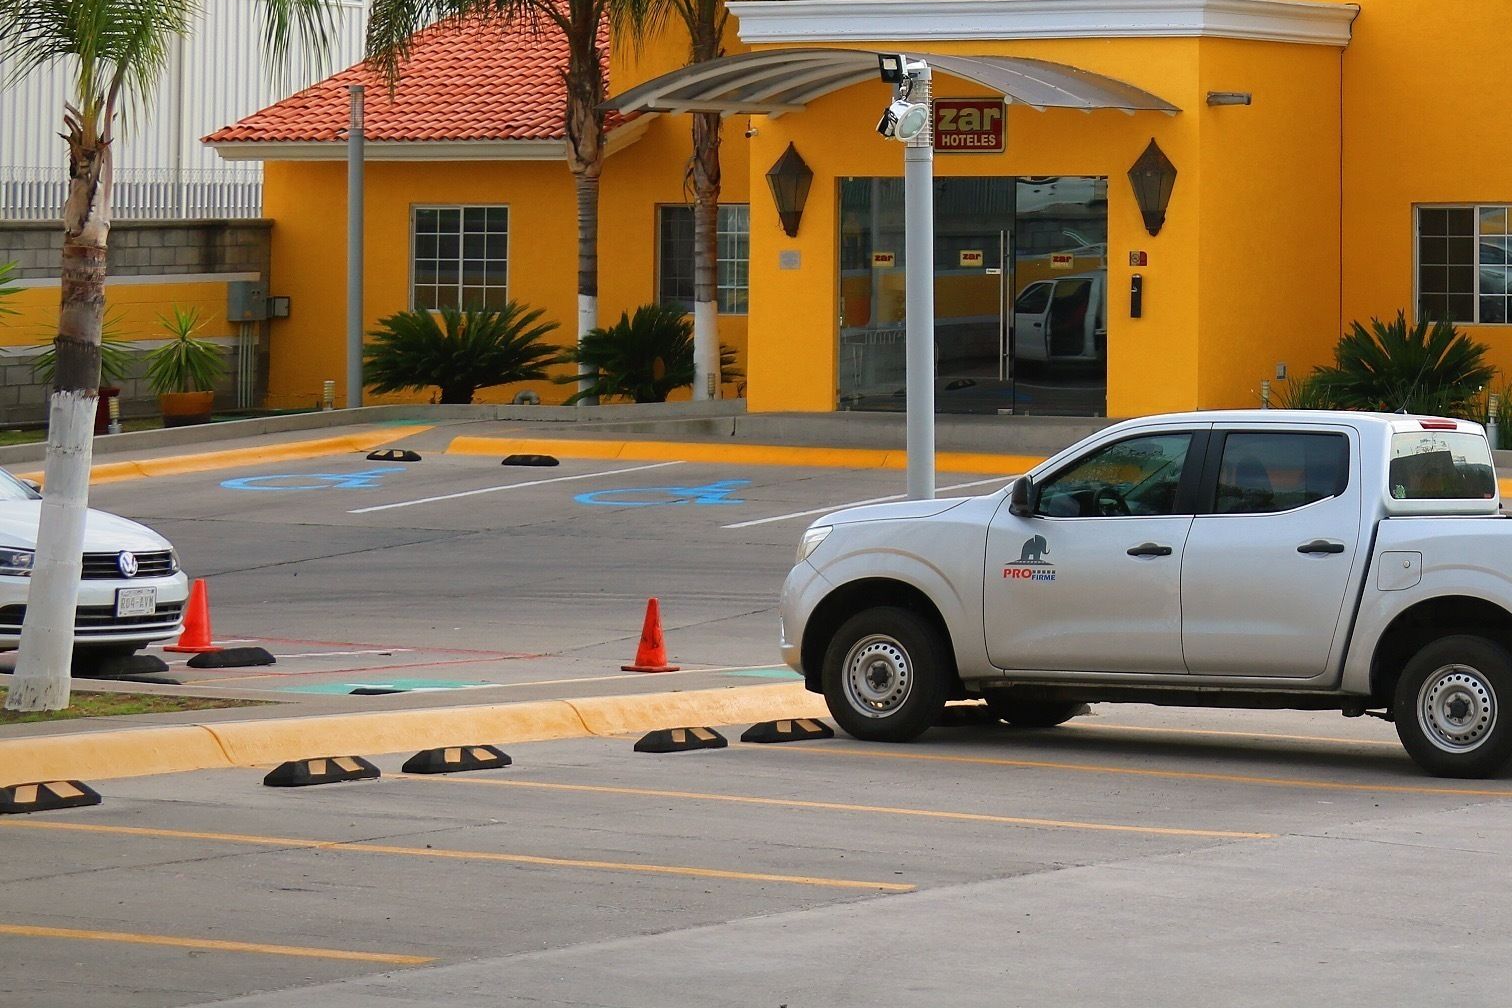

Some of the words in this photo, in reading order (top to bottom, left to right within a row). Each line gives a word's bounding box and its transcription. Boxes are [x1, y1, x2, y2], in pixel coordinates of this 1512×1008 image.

[938, 107, 1000, 132] zar
[941, 134, 996, 146] HOTELES
[874, 254, 894, 262] zar
[962, 253, 982, 261] zar
[1003, 568, 1032, 579] PRO
